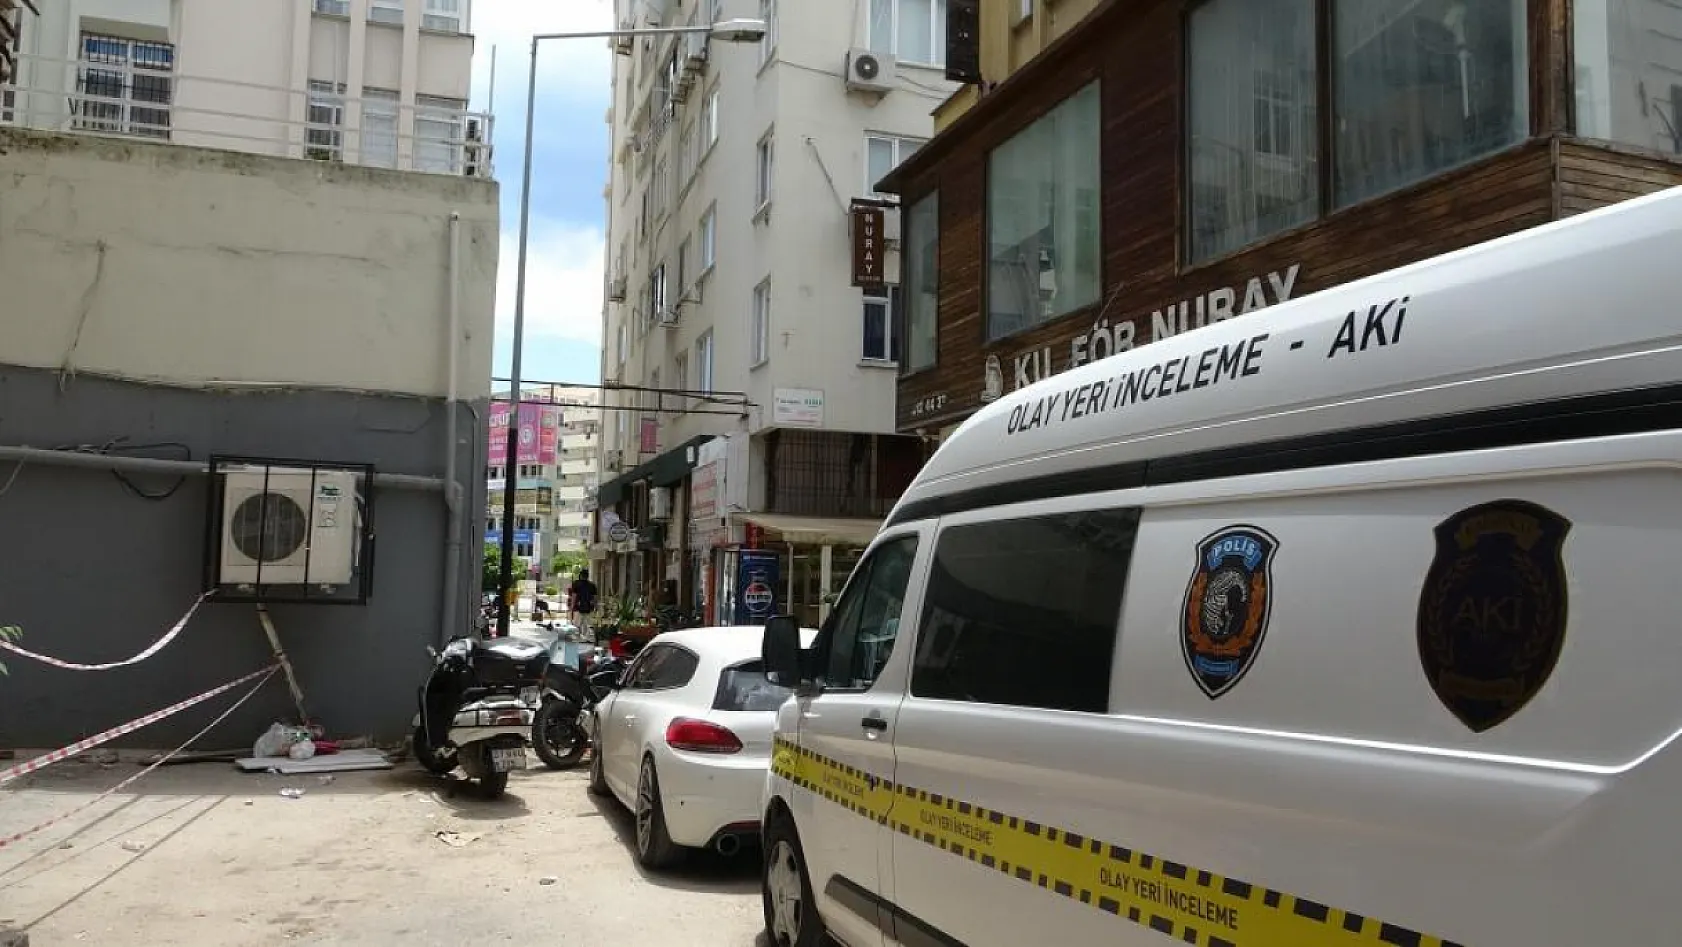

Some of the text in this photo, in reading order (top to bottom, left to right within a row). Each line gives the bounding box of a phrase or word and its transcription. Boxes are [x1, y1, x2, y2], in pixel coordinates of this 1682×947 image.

[864, 213, 874, 274] NURAY
[1152, 263, 1301, 342] NURAY
[1007, 391, 1061, 436] OLAY
[1100, 867, 1131, 893] OLAY
